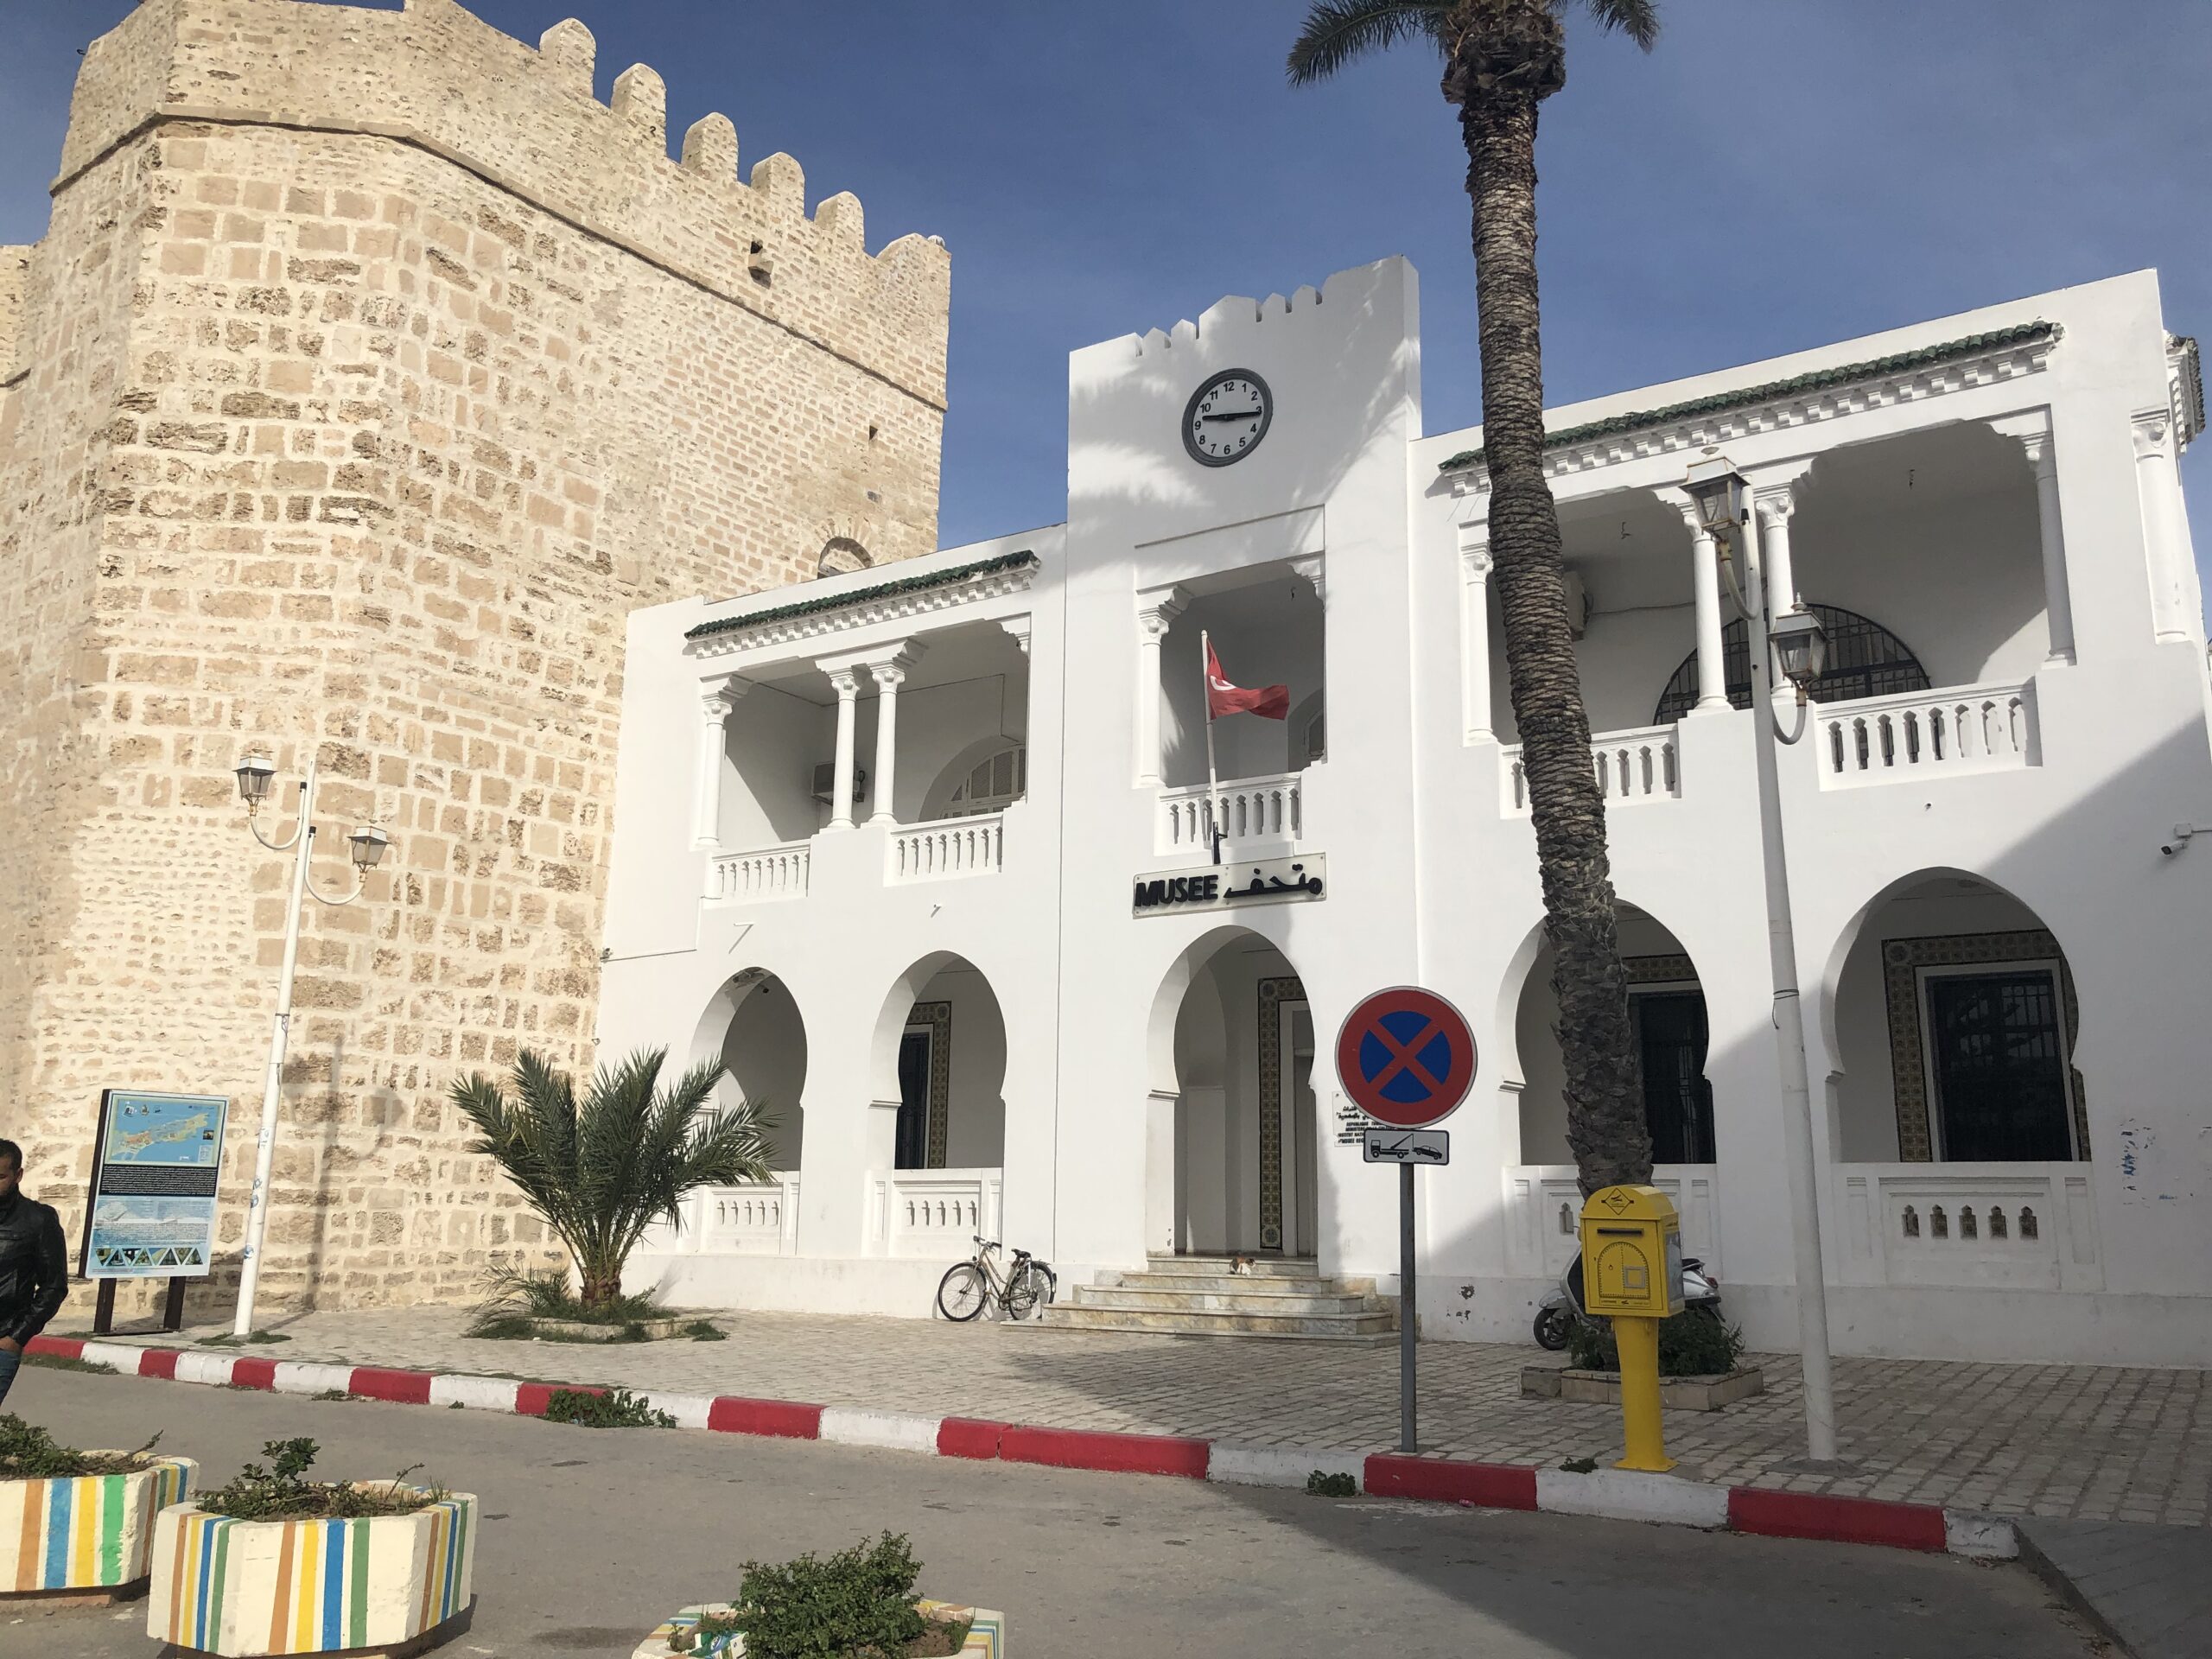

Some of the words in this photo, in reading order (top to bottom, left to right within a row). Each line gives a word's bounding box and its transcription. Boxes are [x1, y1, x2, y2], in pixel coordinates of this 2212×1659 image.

[1224, 381, 1235, 392] 12
[1242, 383, 1247, 392] 1
[1210, 390, 1218, 400] 11
[1251, 391, 1257, 401] 2
[1200, 403, 1211, 413] 10
[1255, 406, 1262, 415] 3
[1194, 421, 1201, 430] 9
[1250, 423, 1256, 433] 4
[1199, 435, 1205, 445] 8
[1239, 437, 1246, 448] 5
[1211, 443, 1217, 454] 7
[1224, 445, 1230, 454] 6
[1224, 863, 1323, 899] متحف
[1135, 874, 1218, 907] MUSEE
